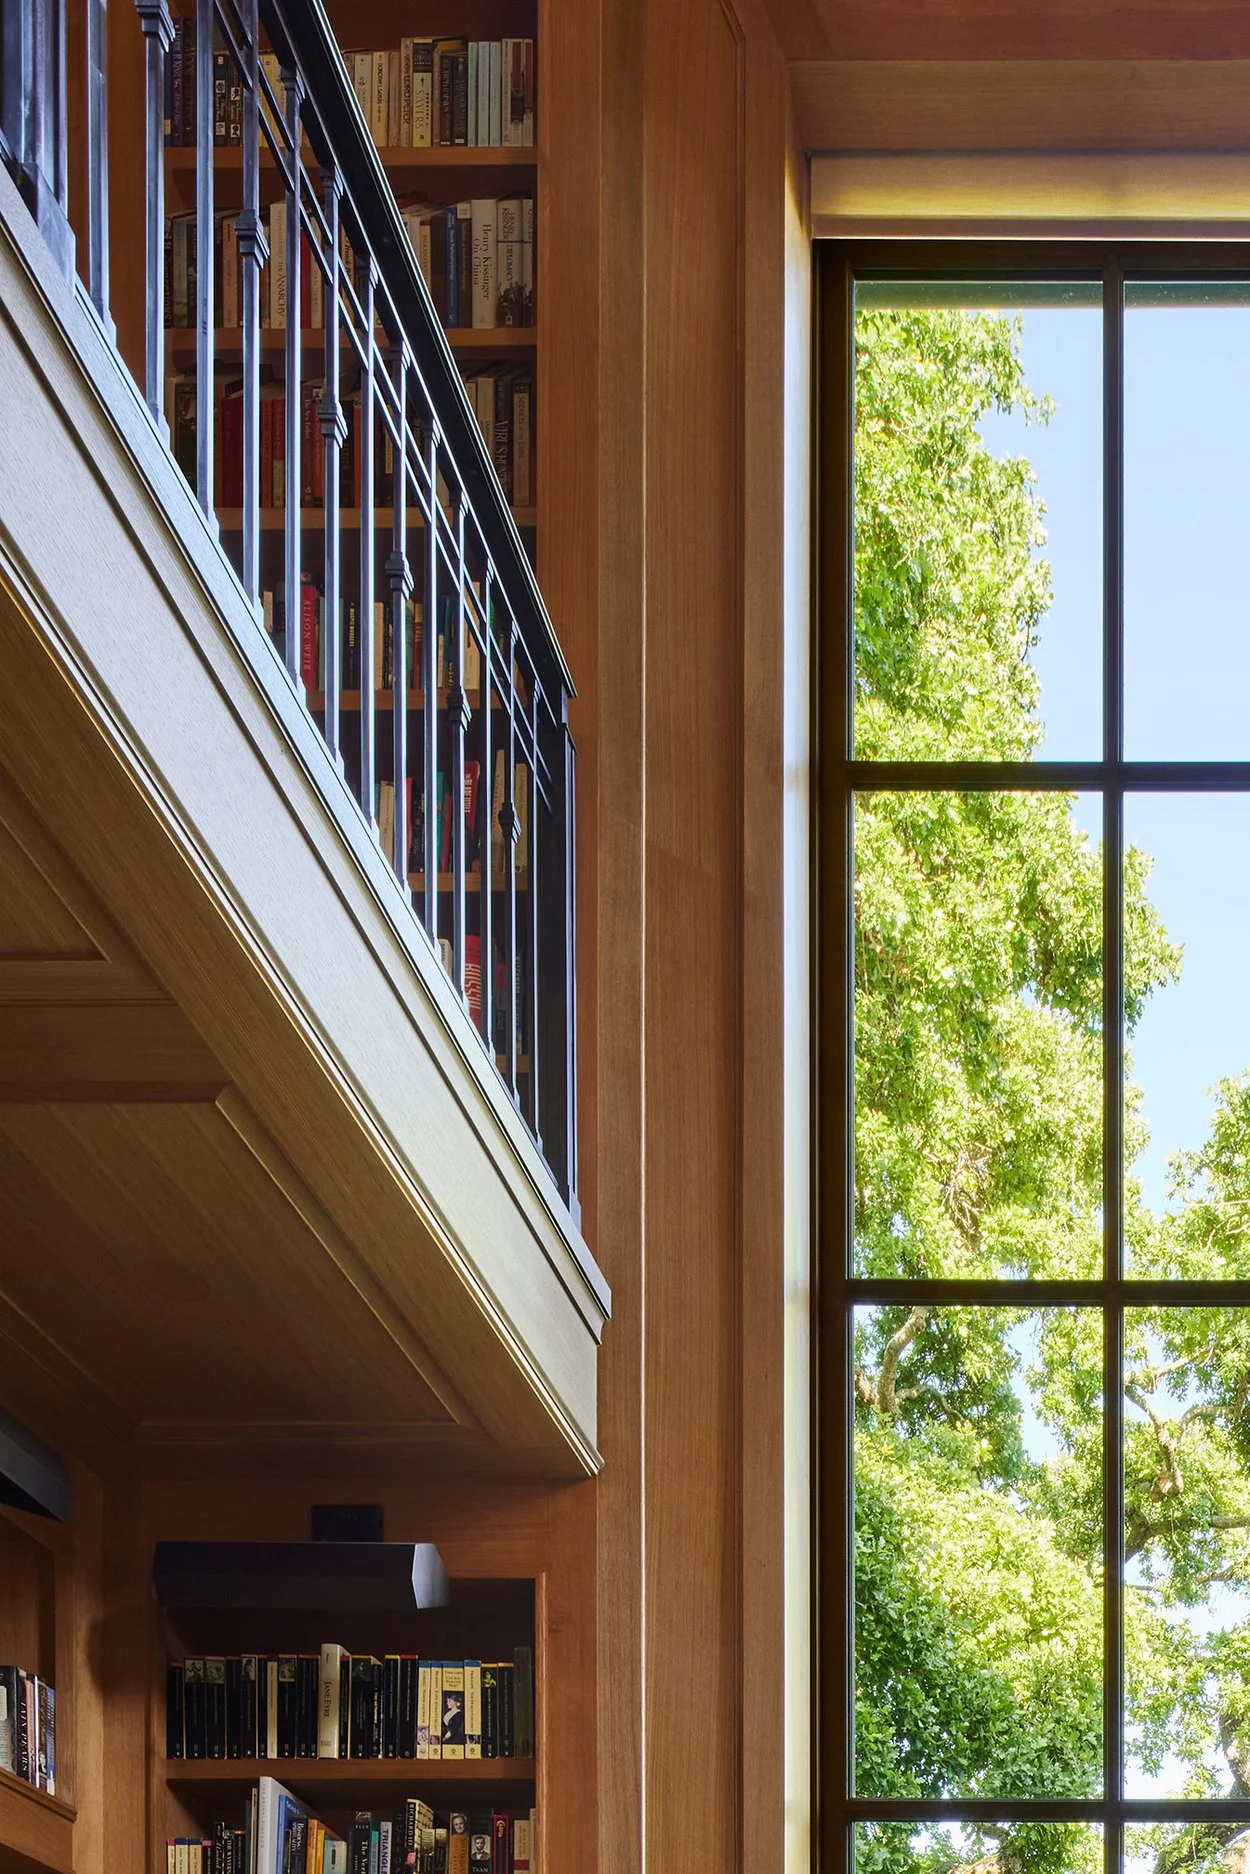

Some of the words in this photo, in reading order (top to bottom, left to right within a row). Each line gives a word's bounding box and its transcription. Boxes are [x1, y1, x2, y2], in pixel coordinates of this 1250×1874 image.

[473, 239, 482, 254] On
[482, 224, 492, 253] Henry
[473, 259, 482, 285] China
[482, 257, 492, 300] Kissinger
[303, 599, 312, 639] ALISON
[303, 643, 312, 671] WEIR
[323, 1680, 334, 1698] JANE
[323, 1699, 334, 1718] EYRE
[407, 1803, 415, 1835] RICHARD
[360, 1840, 369, 1855] The
[407, 1837, 415, 1847] III
[472, 1866, 489, 1874] TEAM
